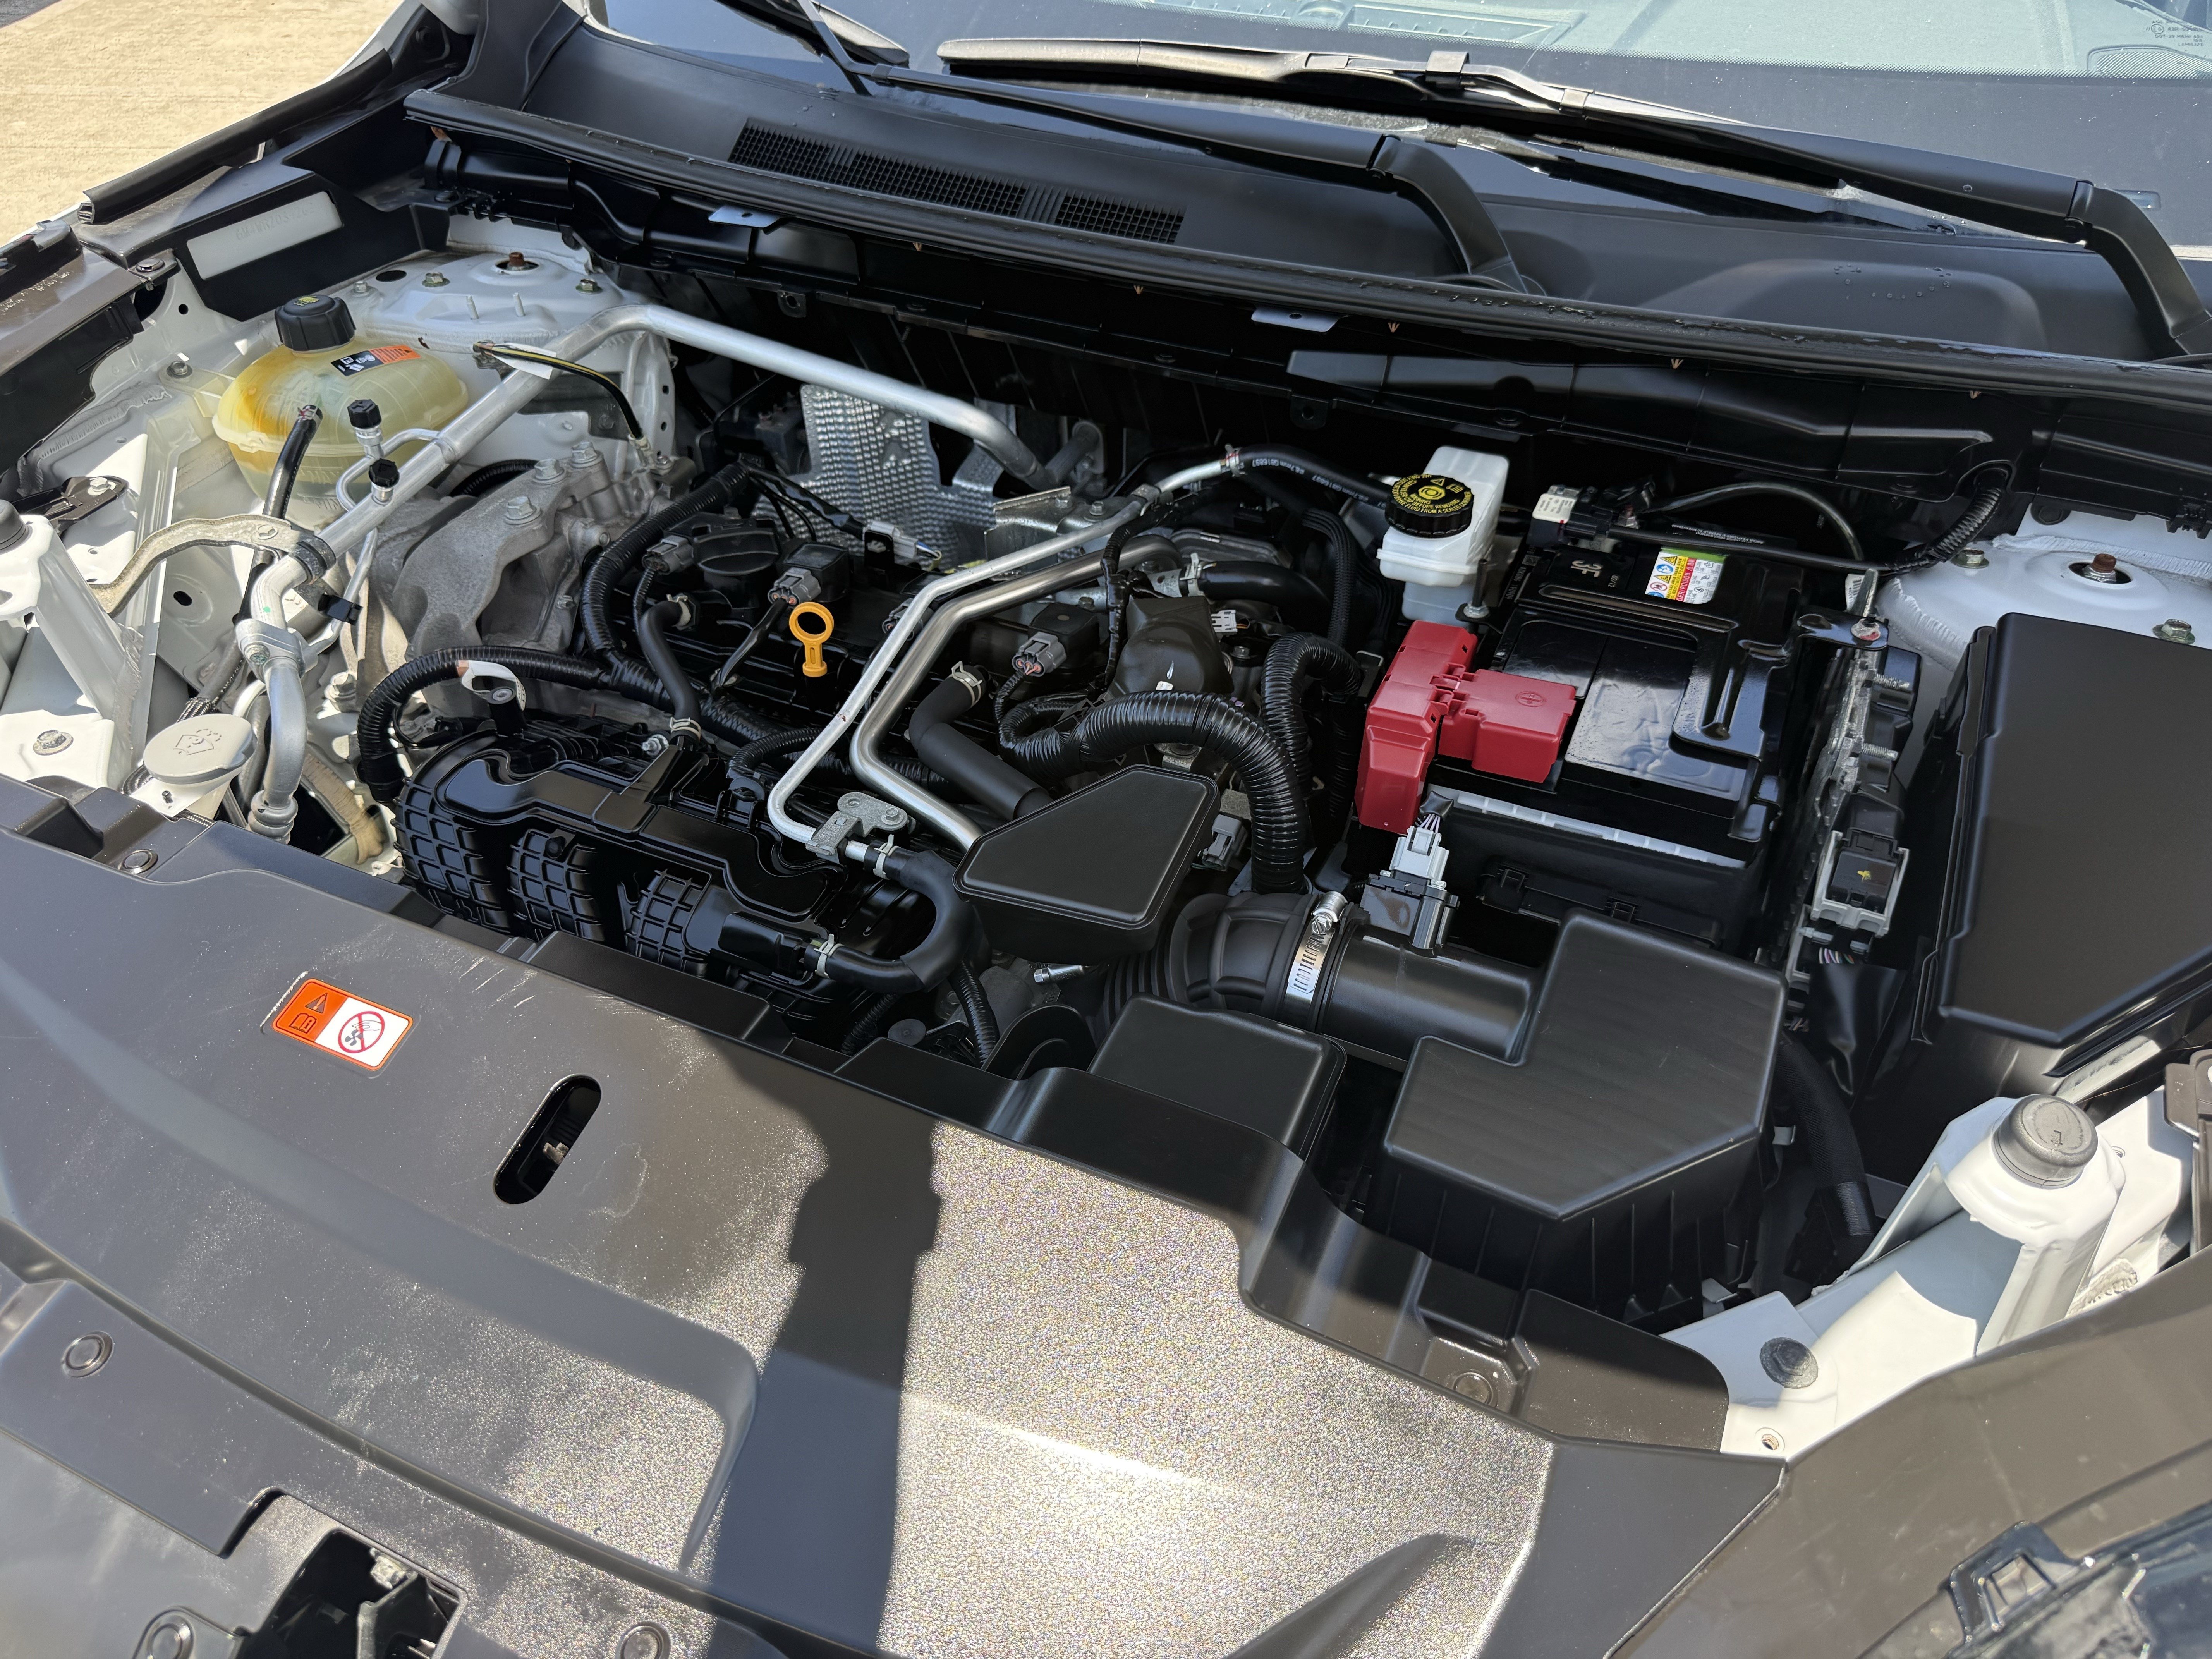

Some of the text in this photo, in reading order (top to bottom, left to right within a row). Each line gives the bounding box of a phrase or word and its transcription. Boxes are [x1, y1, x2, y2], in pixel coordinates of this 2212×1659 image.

[1443, 504, 1462, 513] SEALED
[1571, 560, 1604, 577] 3F
[1676, 572, 1691, 602] GER/POISON
